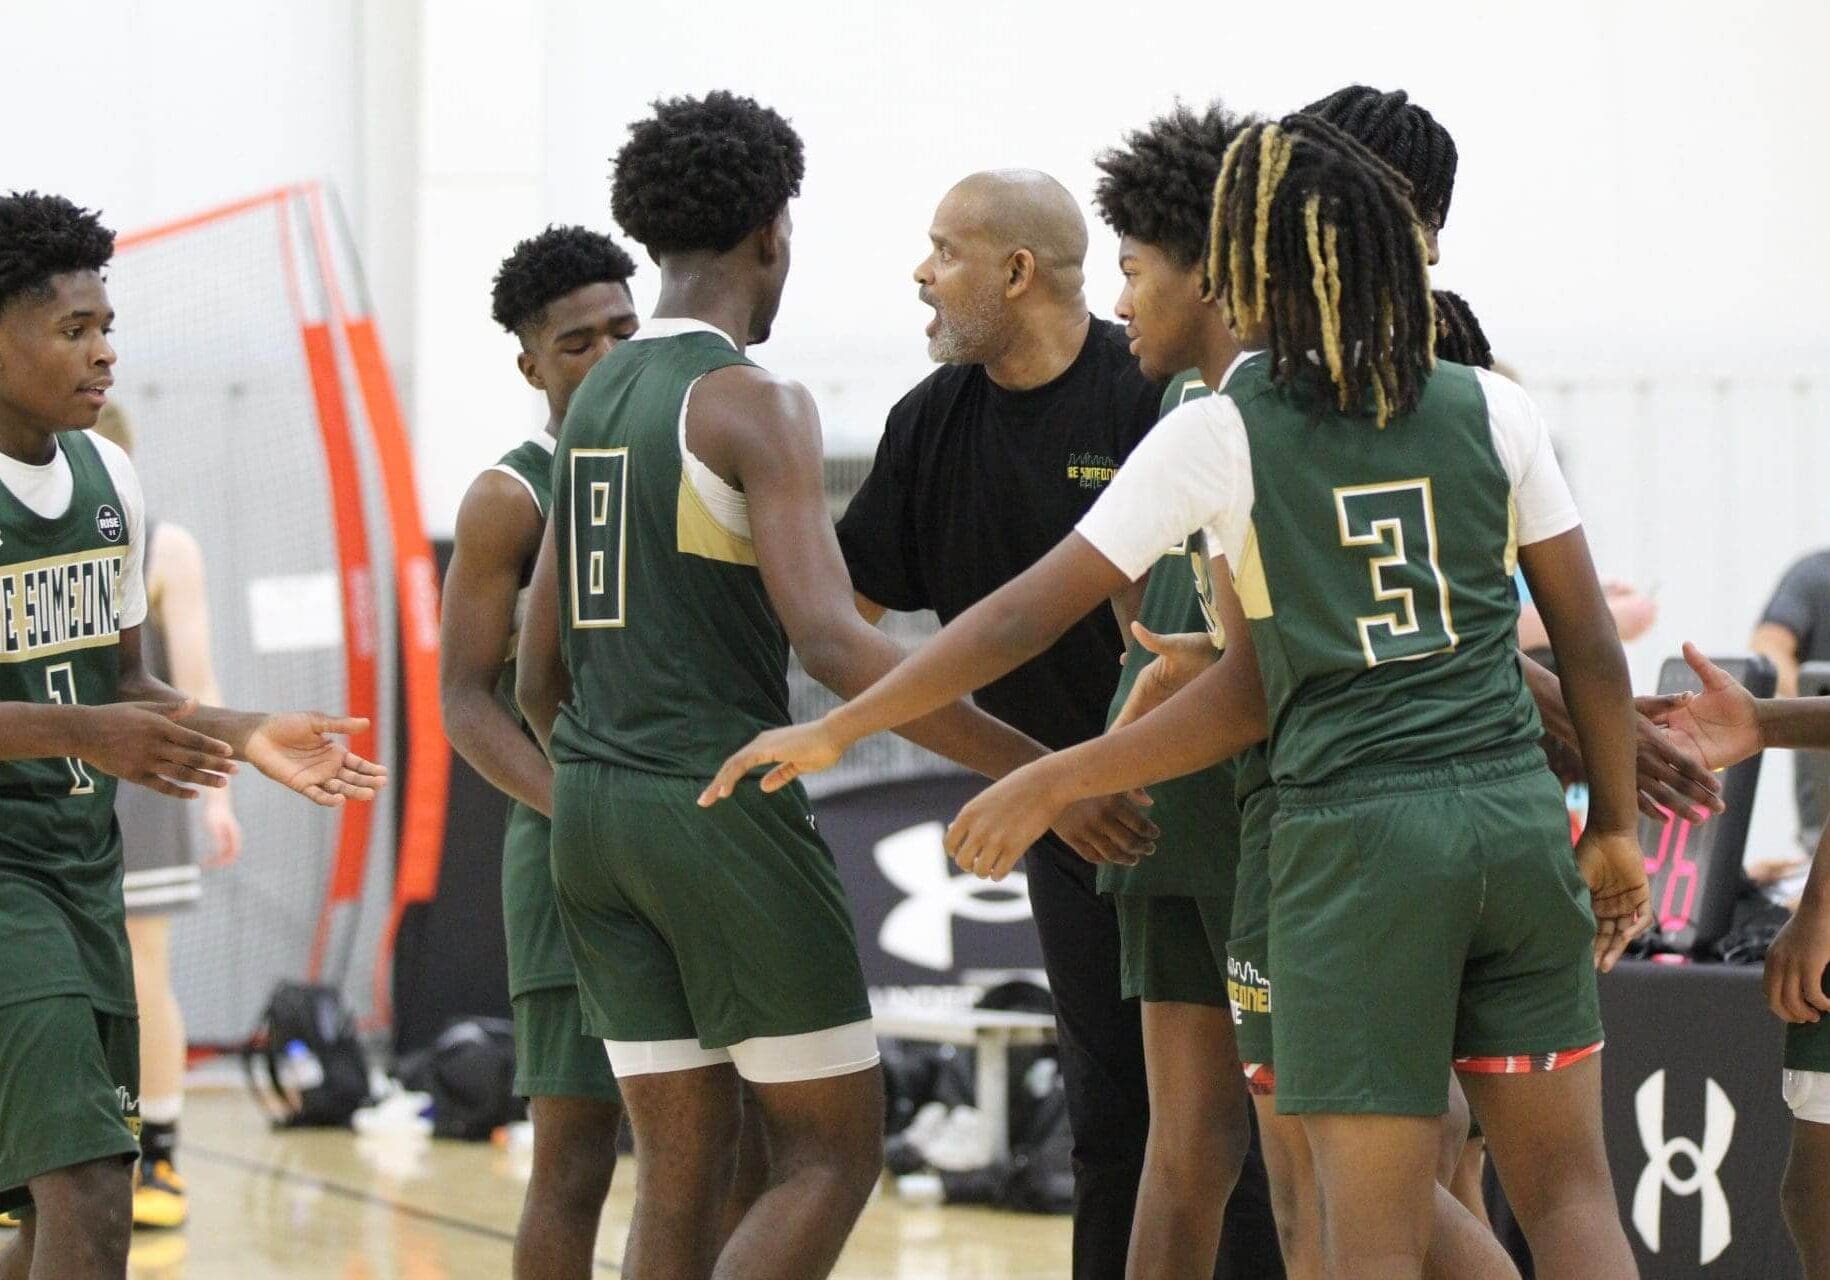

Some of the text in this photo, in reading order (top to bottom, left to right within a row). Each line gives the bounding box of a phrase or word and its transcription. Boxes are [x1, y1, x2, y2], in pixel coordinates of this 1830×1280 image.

[99, 517, 120, 529] RISE
[570, 447, 629, 629] 8
[1333, 477, 1459, 668] 3
[0, 574, 20, 654] E
[45, 661, 95, 795] 1
